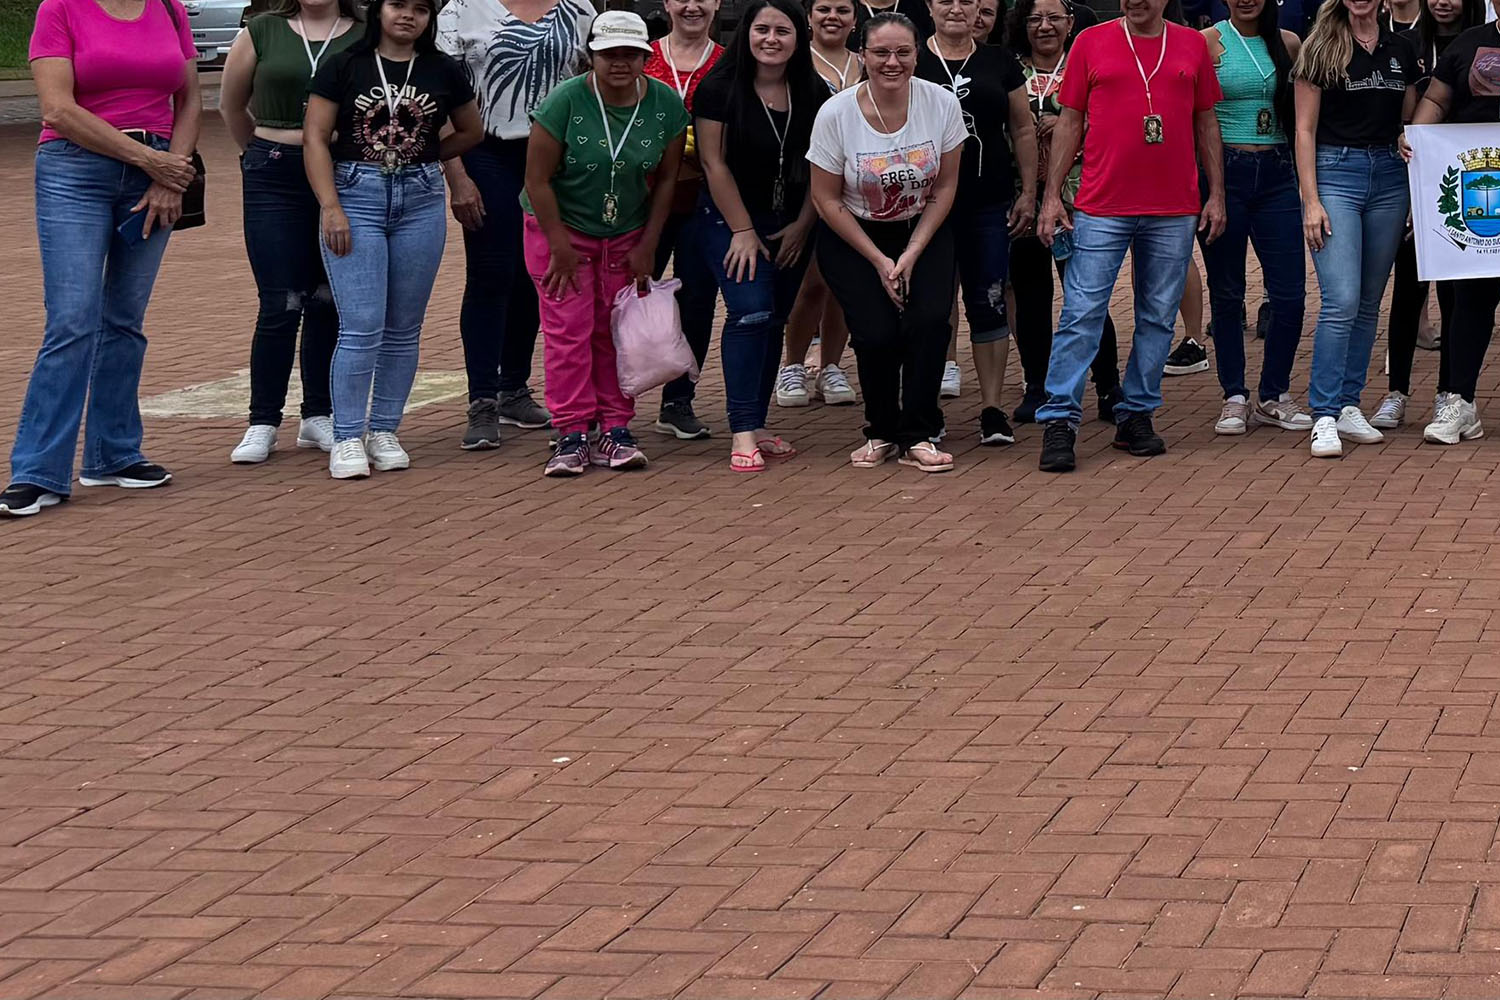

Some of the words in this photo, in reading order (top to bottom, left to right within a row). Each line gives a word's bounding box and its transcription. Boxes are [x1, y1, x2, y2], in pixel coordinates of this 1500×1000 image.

[880, 169, 916, 185] FREE
[1450, 229, 1466, 241] SANTO
[1464, 236, 1485, 246] ANTONIO
